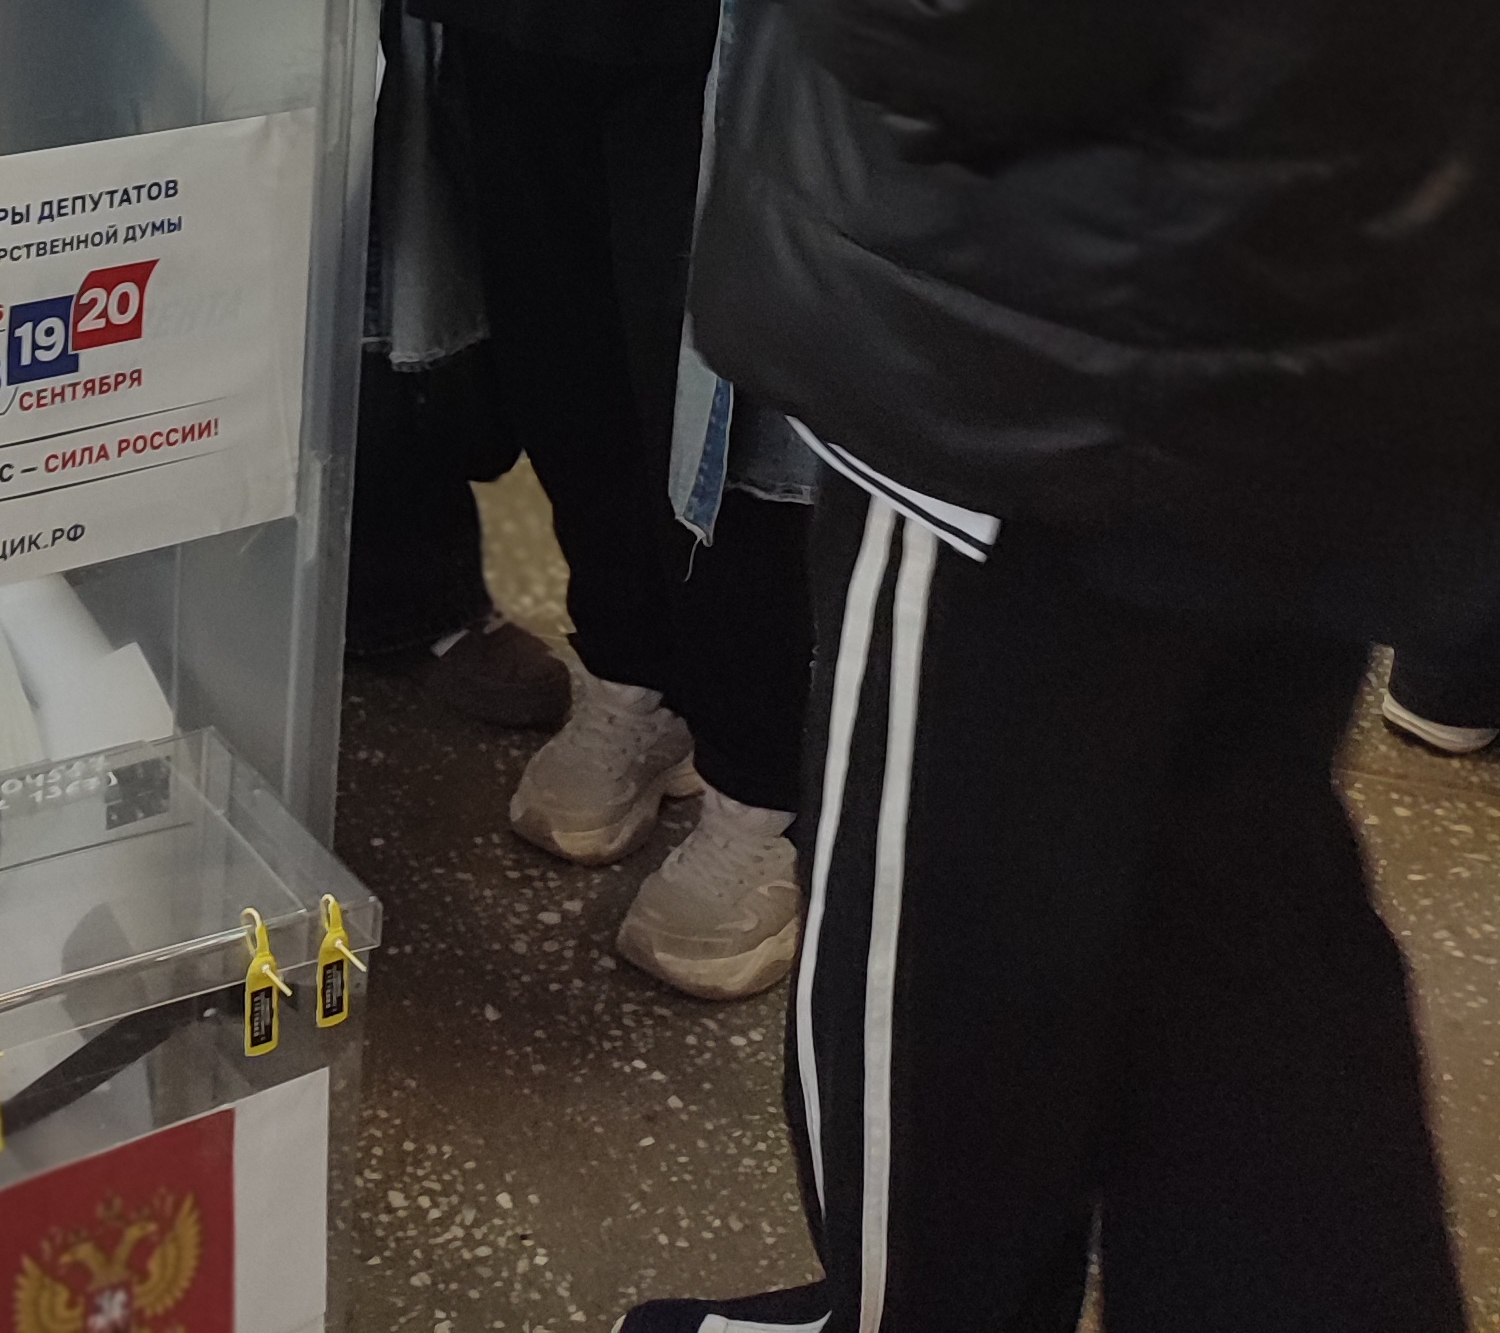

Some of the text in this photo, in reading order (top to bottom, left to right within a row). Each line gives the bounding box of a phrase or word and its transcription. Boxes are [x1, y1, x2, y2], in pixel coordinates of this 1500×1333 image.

[37, 178, 179, 225] ДЕПУТАТОВ
[123, 215, 183, 247] ДУМЫ
[76, 281, 140, 333] 20
[13, 317, 66, 366] 19
[18, 368, 143, 412] СЕНТЯБРЯ
[44, 442, 111, 474] СИЛА
[116, 417, 219, 459] РОССИИ!
